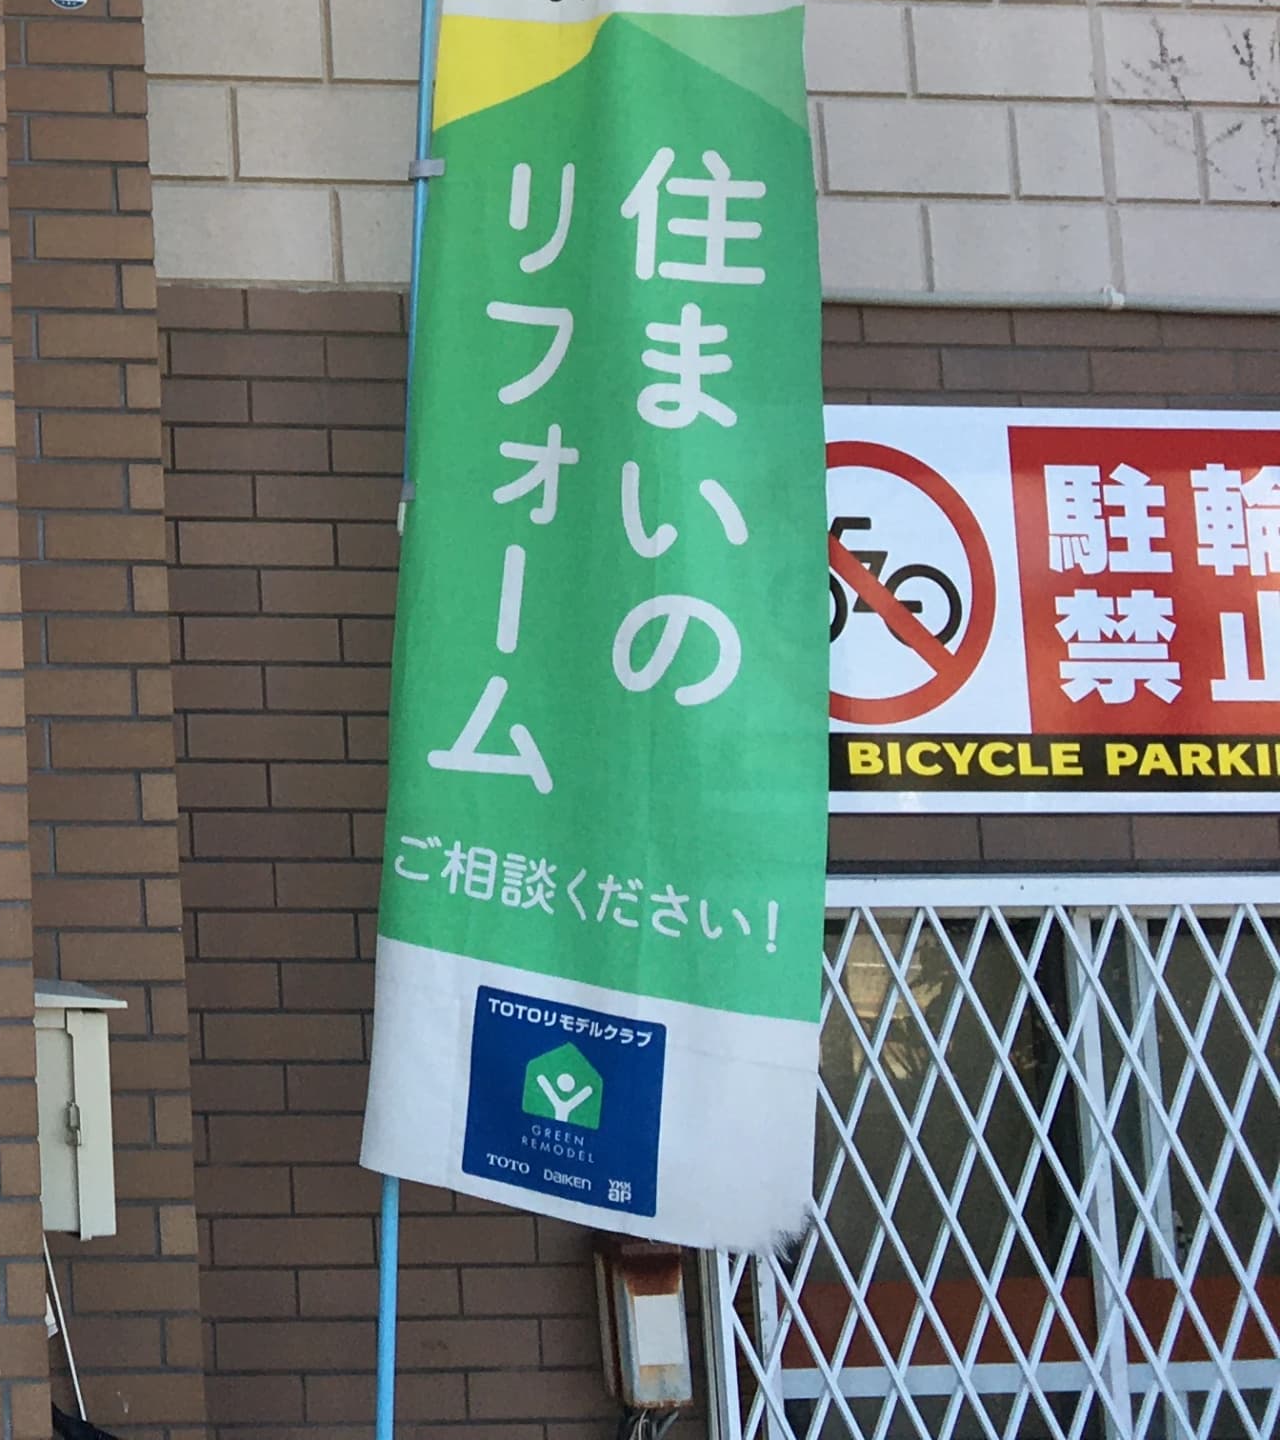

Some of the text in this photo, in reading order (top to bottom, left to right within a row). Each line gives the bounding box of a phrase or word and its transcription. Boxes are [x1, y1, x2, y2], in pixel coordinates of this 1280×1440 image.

[612, 146, 767, 707] 住まいの
[426, 162, 580, 794] リフォーム
[1043, 462, 1280, 575] 駐輪
[1055, 589, 1280, 704] 禁止
[847, 741, 1280, 777] BICYCLE PARKI
[394, 835, 780, 953] ご相談ください!
[488, 998, 653, 1047] TOTOリモデルクラブ
[486, 1153, 530, 1174] TOTO
[521, 1135, 595, 1164] REMODEL
[531, 1124, 585, 1147] GREEN
